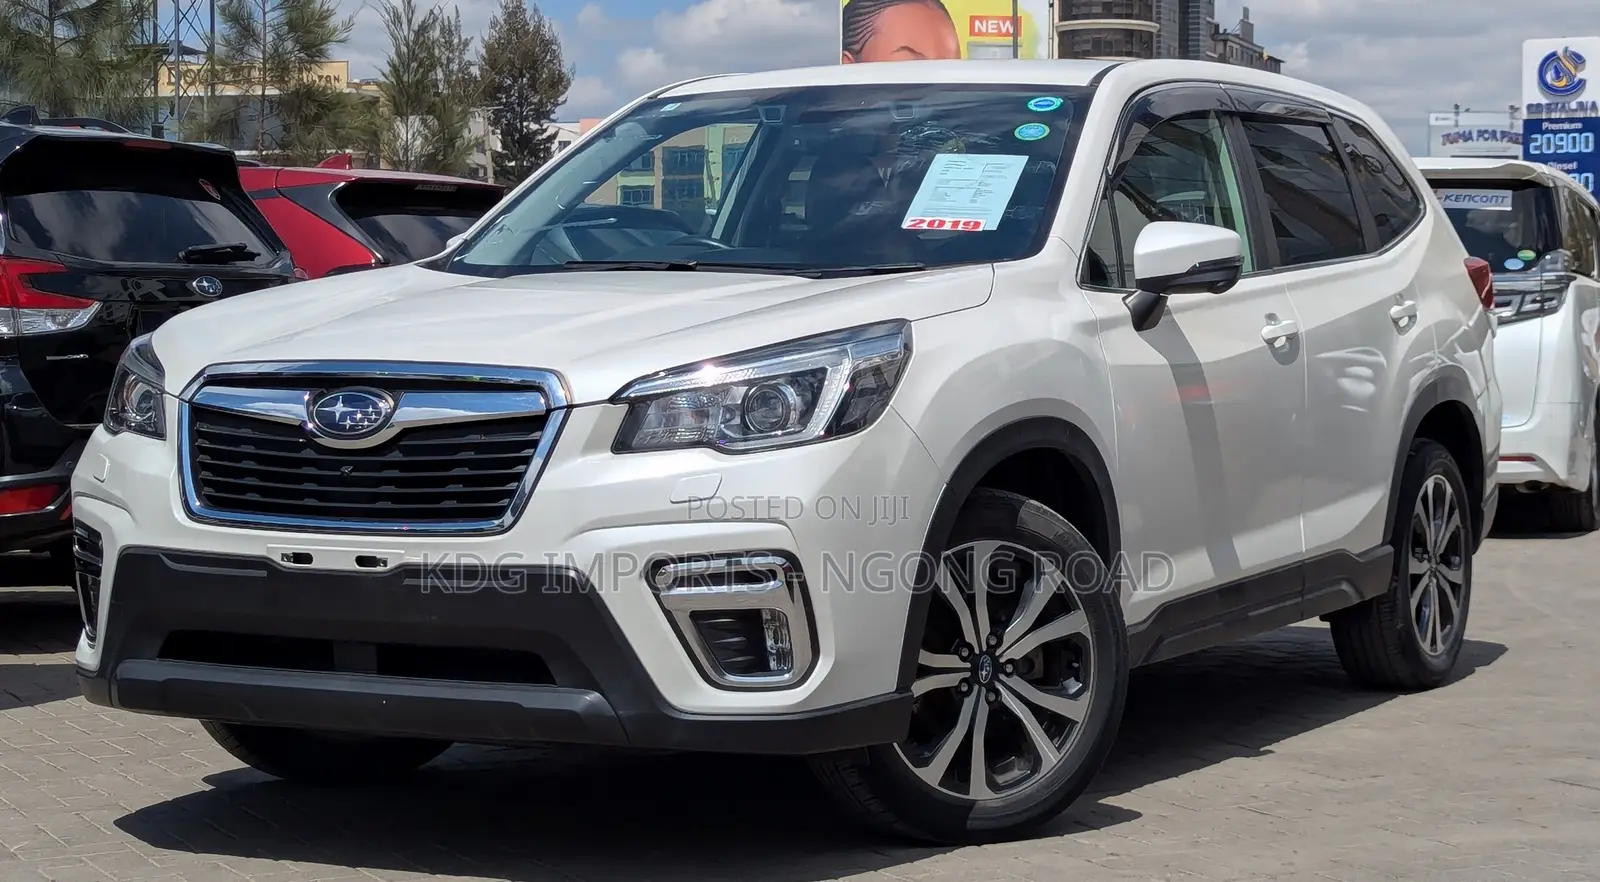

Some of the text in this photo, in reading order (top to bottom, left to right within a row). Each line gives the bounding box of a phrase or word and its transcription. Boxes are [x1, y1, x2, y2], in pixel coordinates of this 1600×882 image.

[974, 20, 1013, 33] NEW
[1542, 122, 1583, 130] Premium
[1476, 129, 1499, 142] FOR
[907, 218, 982, 230] 2019
